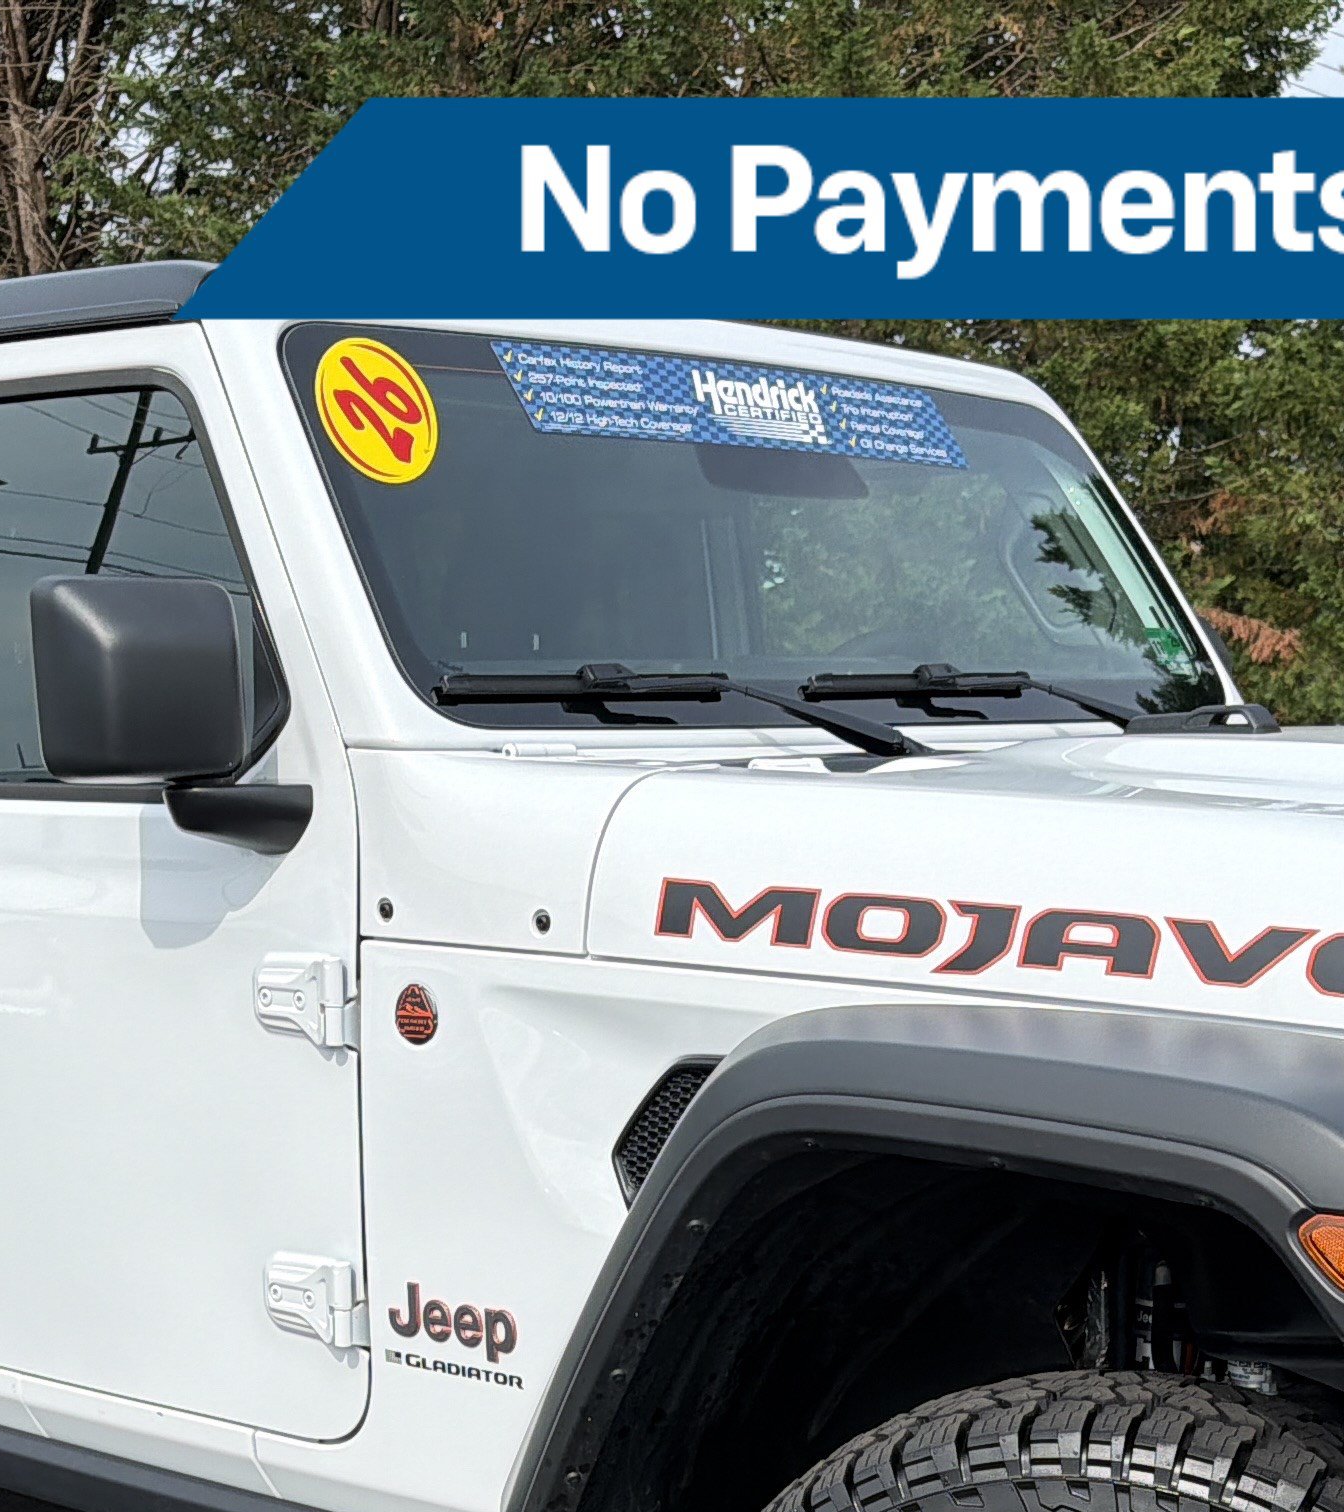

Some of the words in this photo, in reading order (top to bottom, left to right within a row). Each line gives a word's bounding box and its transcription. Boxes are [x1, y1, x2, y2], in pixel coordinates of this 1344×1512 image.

[560, 357, 600, 372] History
[604, 361, 643, 375] Report
[540, 392, 582, 406] 10/100
[691, 369, 820, 415] Hendrick
[333, 356, 422, 464] 26
[550, 411, 584, 425] 12/12
[640, 417, 693, 434] Coverage
[723, 404, 822, 425] CERTIFIED
[388, 1281, 518, 1364] Jeep
[405, 1353, 524, 1390] GLADIATOR
